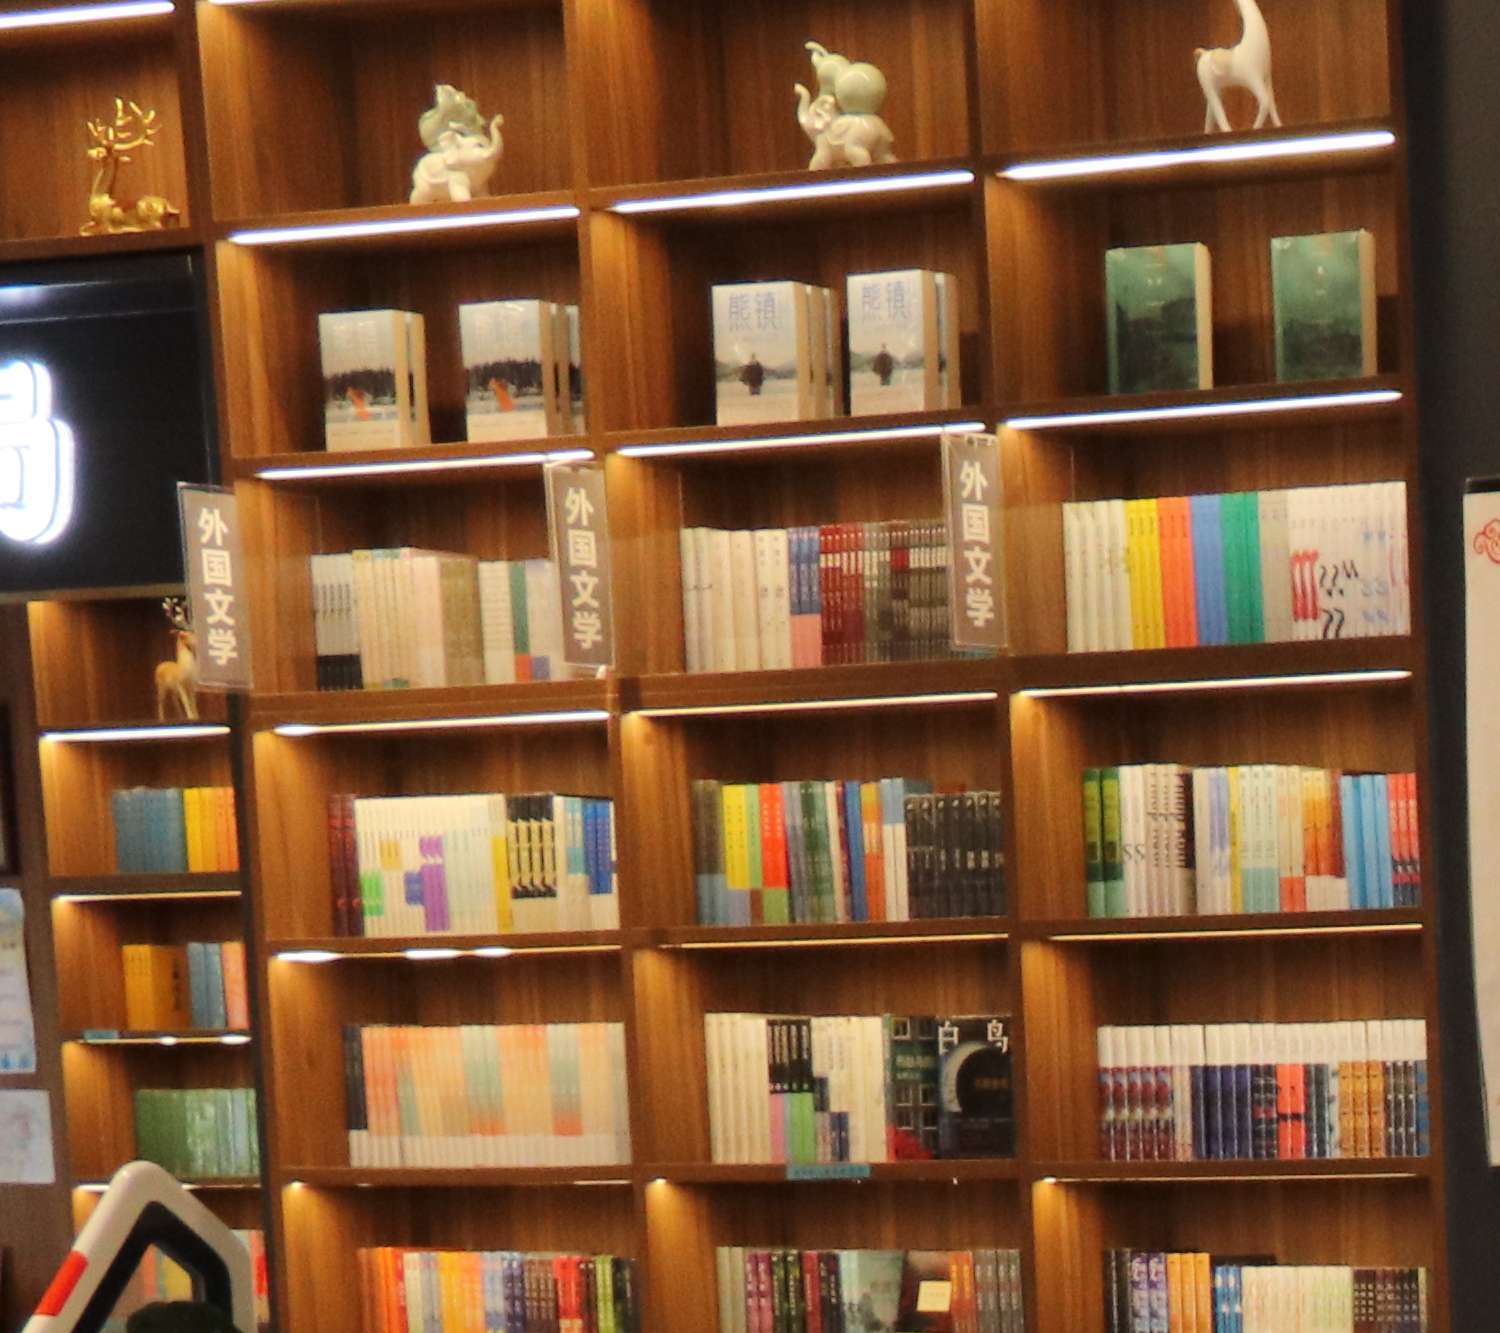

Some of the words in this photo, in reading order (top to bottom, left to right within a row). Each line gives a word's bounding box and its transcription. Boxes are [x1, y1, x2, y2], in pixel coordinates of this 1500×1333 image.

[197, 507, 239, 666] 外国文学
[565, 487, 604, 651] 外国文学
[960, 460, 995, 628] 外国文学
